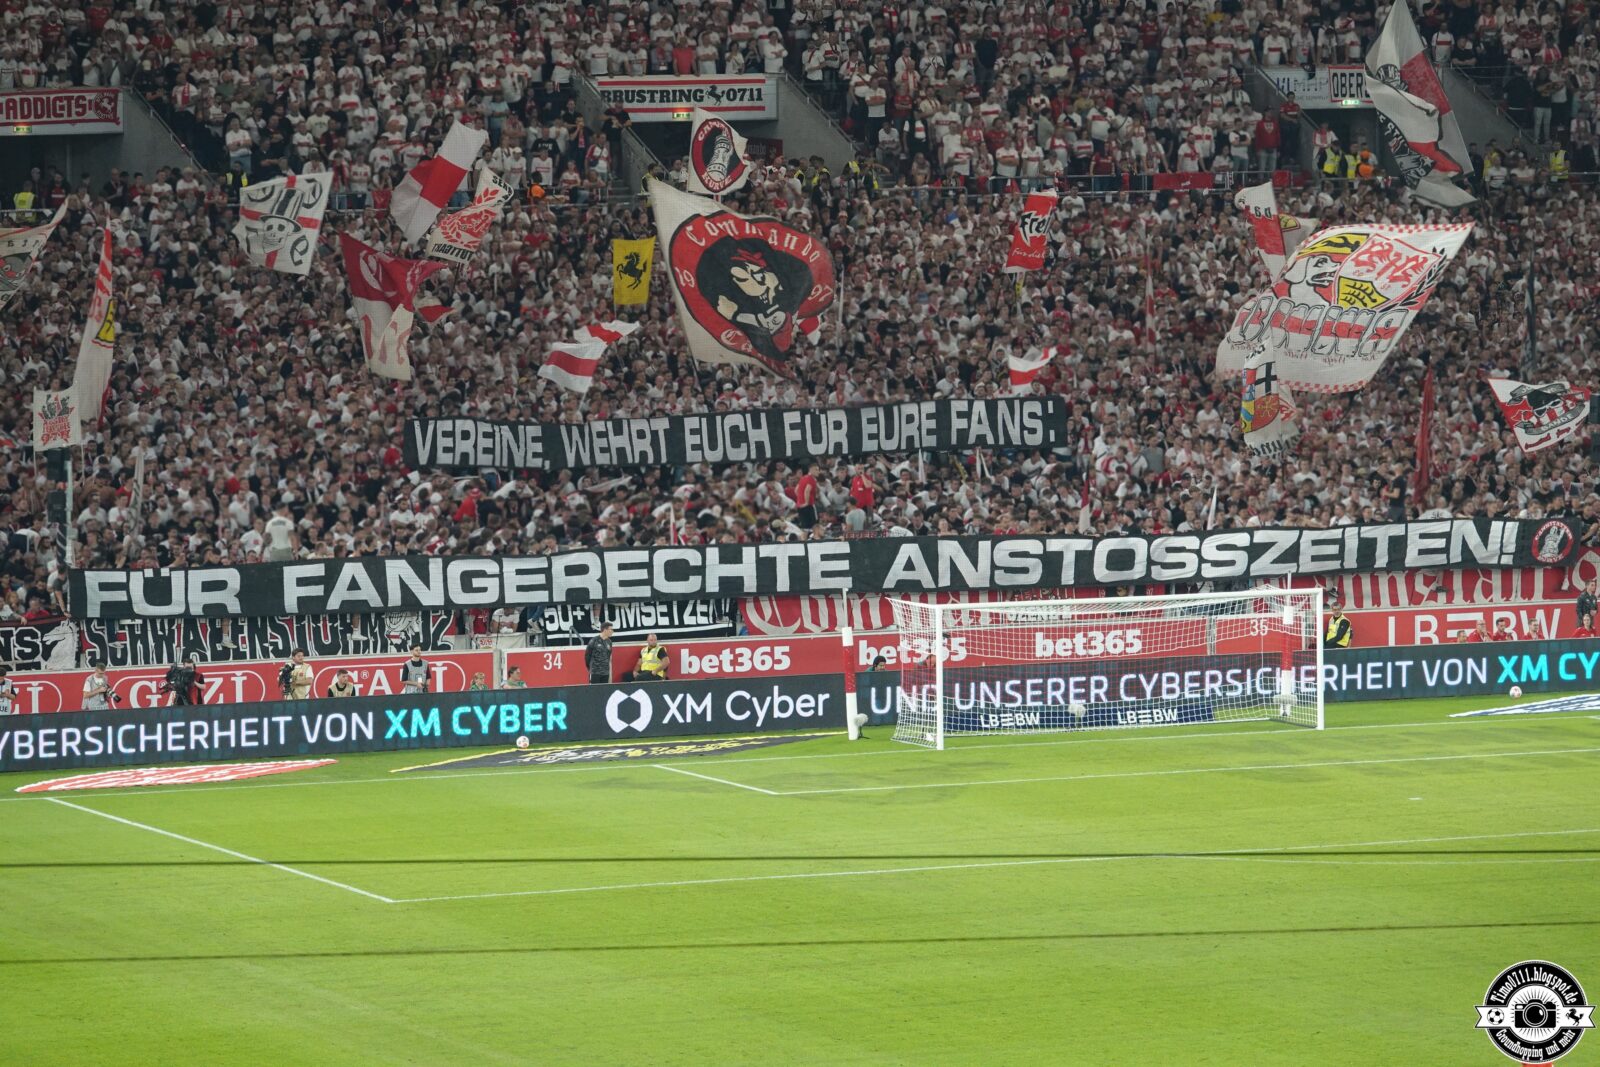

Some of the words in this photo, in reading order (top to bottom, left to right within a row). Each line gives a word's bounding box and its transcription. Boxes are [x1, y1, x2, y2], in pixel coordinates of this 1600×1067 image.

[600, 88, 704, 103] BRUSTRING
[726, 88, 763, 101] 0711
[1332, 73, 1370, 98] OBER
[5, 95, 87, 120] ADDICTS
[686, 219, 820, 262] Commando
[675, 267, 695, 288] 19
[808, 284, 833, 301] 97
[414, 419, 550, 470] VEREINE,
[560, 416, 670, 468] WEHRT
[684, 412, 771, 462] EUCH
[783, 407, 848, 456] FÜR
[861, 400, 937, 451] EURE
[84, 567, 241, 617] FÜR
[283, 541, 852, 613] FANGERECHTE
[882, 519, 1519, 588] ANSTOSSZEITEN!
[1250, 619, 1268, 636] 35
[858, 636, 967, 665] bet365
[1035, 628, 1143, 658] bet365
[543, 653, 562, 670] 34
[680, 645, 791, 674] bet365
[955, 674, 1109, 711] UNSERER
[1422, 657, 1487, 687] VON
[1497, 654, 1549, 683] XM
[663, 693, 712, 724] XM
[726, 685, 830, 727] Cyber
[301, 711, 374, 743] VON
[384, 708, 441, 739] XM
[452, 702, 568, 735] CYBER
